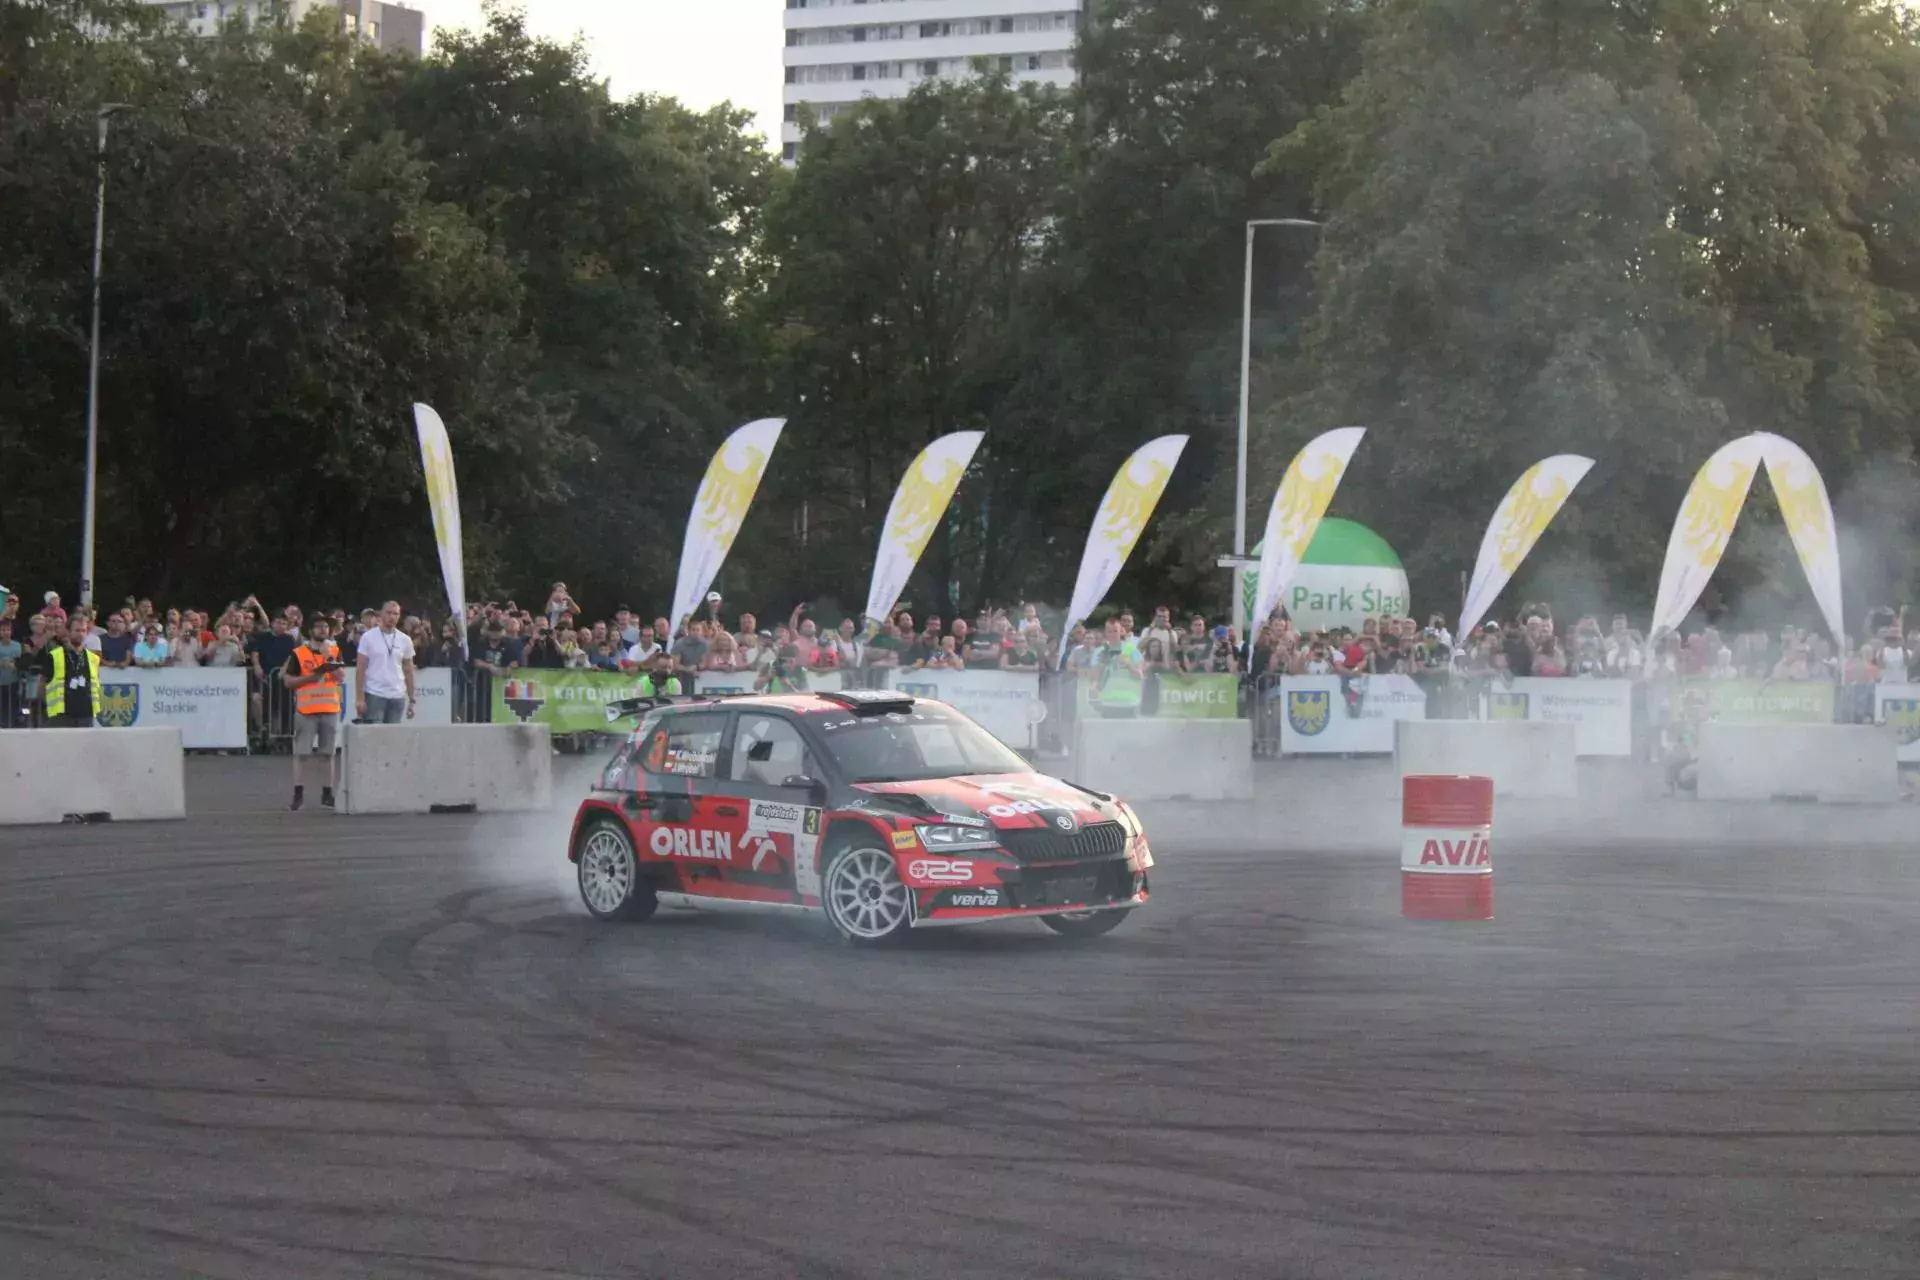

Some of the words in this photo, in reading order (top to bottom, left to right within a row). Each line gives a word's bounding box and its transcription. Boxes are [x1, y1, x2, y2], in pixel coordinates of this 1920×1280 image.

[1292, 586, 1353, 612] Park
[1161, 689, 1229, 704] TOWICE
[987, 799, 1084, 818] ORL
[807, 810, 817, 833] 3
[650, 826, 732, 860] ORLEN
[1420, 833, 1490, 866] AVIA
[952, 894, 999, 906] verva
